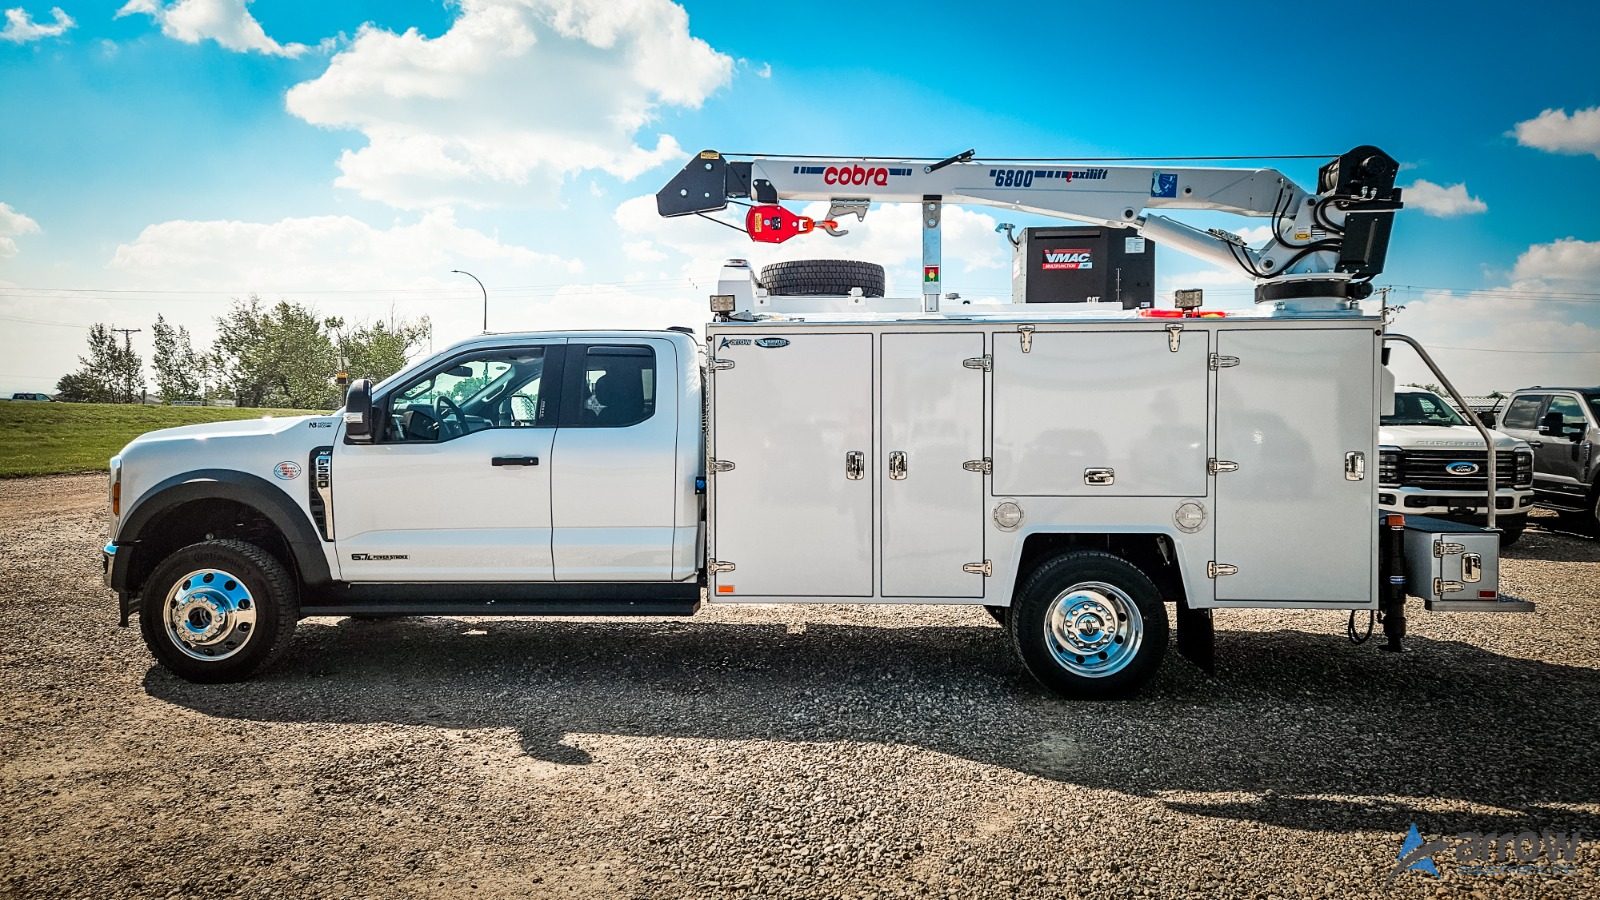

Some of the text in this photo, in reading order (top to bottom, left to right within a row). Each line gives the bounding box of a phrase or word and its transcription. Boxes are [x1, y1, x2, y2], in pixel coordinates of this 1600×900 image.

[824, 164, 888, 187] cobra
[994, 168, 1034, 188] 6800
[1045, 253, 1091, 263] VMAC
[1086, 296, 1101, 304] CAT
